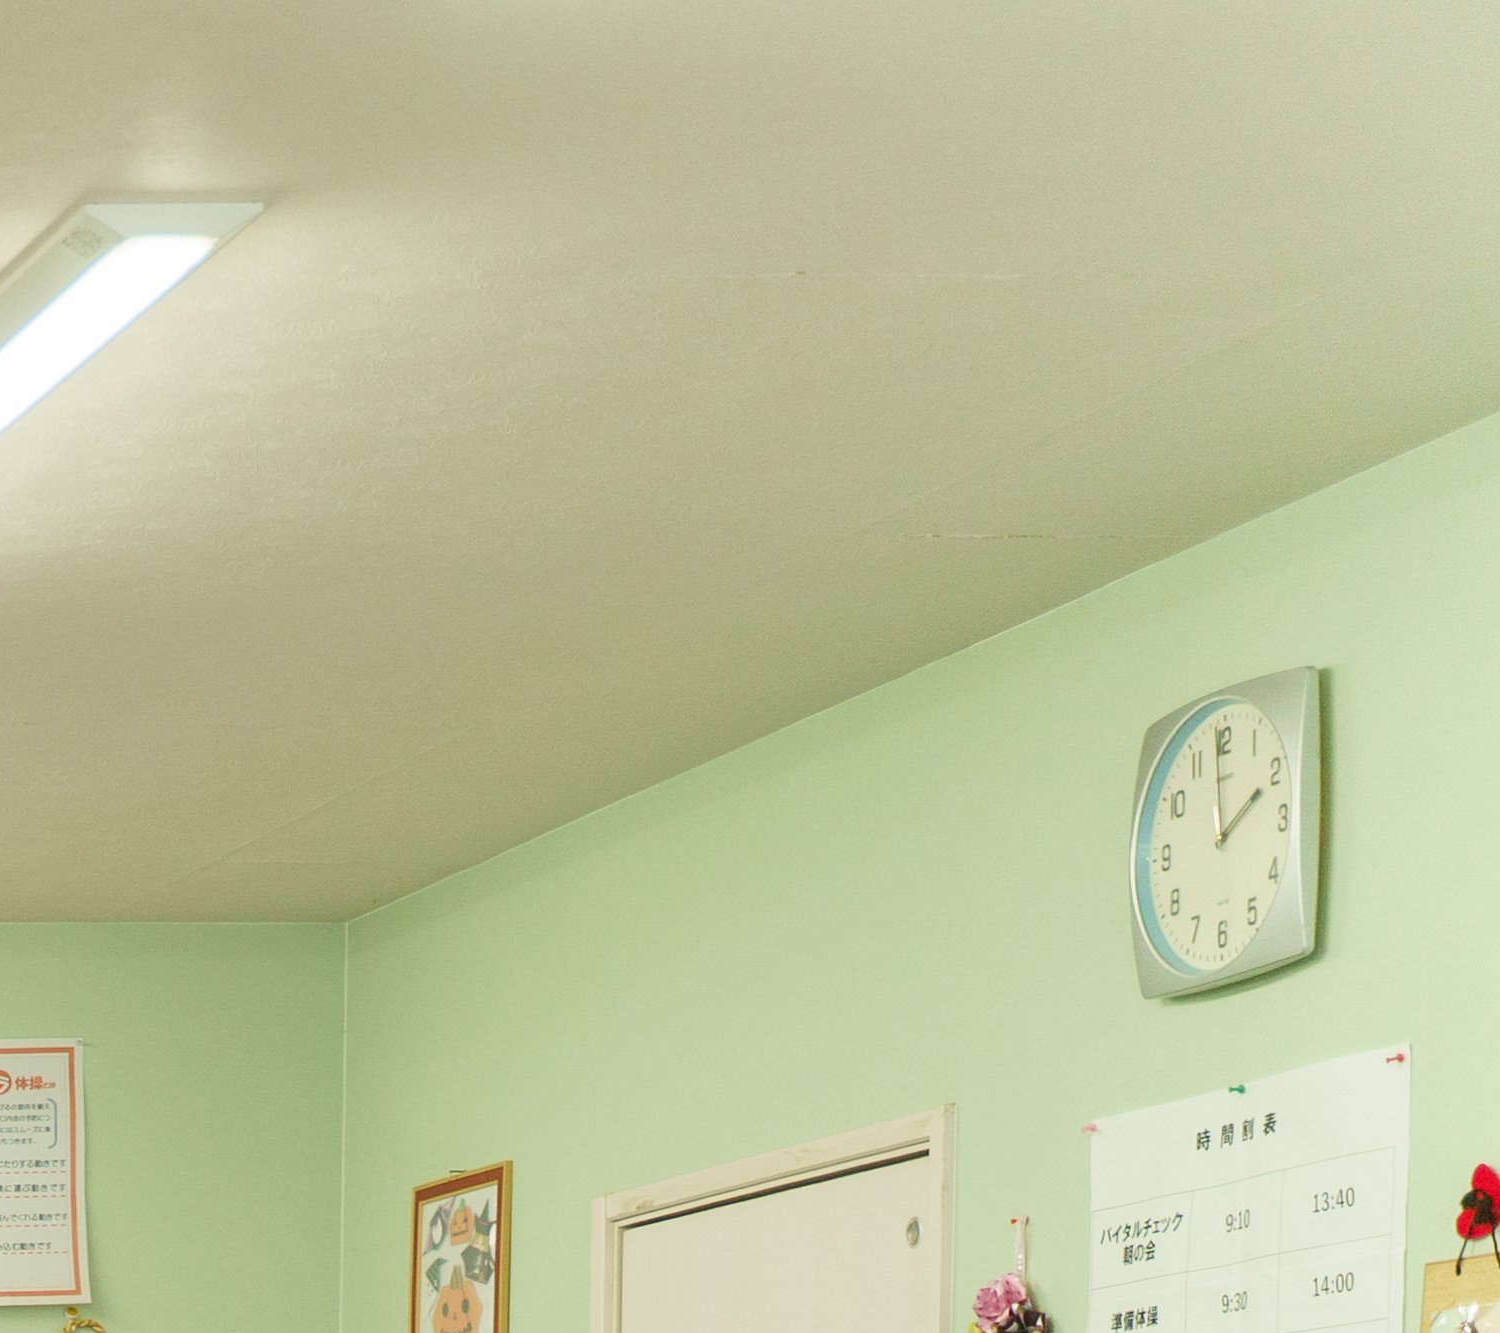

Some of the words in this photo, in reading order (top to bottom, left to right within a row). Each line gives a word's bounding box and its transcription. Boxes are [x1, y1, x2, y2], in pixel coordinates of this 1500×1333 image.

[1218, 726, 1231, 756] 12
[1252, 729, 1256, 757] 1
[1191, 750, 1203, 780] 11
[1270, 757, 1281, 786] 2
[1170, 790, 1185, 820] 10
[1278, 804, 1288, 832] 3
[1161, 845, 1172, 873] 9
[1269, 856, 1278, 884] 4
[1170, 888, 1181, 917] 8
[1247, 897, 1257, 925] 5
[1191, 915, 1201, 944] 7
[1218, 921, 1227, 948] 6
[1195, 1111, 1279, 1152] 時間割表
[1099, 1211, 1184, 1247] バイタルチェック
[1225, 1208, 1251, 1234] 9:10
[1312, 1186, 1356, 1215] 13:40
[1122, 1240, 1157, 1266] 朝の会
[1221, 1290, 1248, 1314] 9:30
[1312, 1271, 1355, 1298] 14:00
